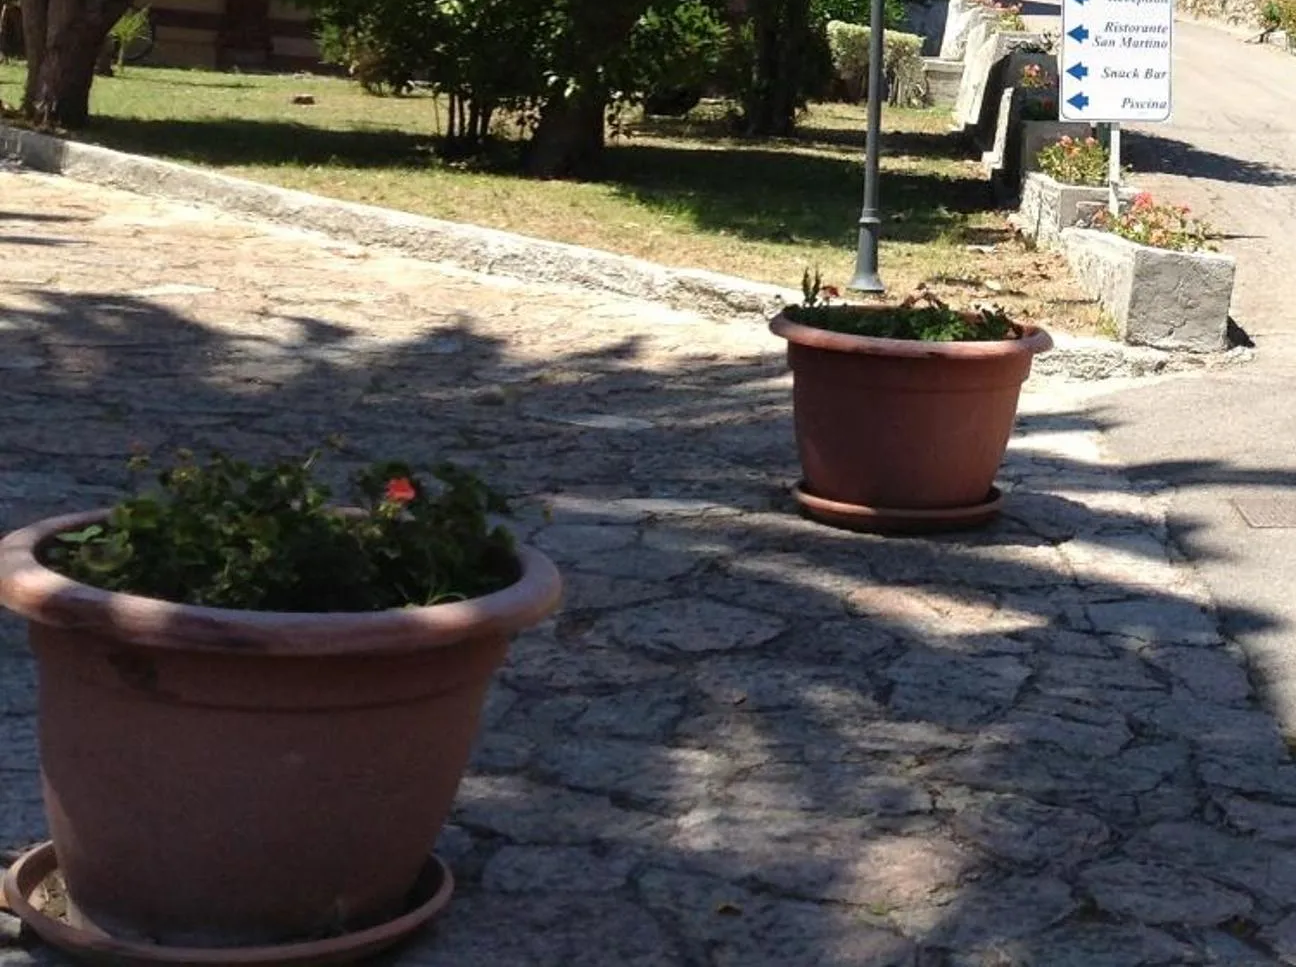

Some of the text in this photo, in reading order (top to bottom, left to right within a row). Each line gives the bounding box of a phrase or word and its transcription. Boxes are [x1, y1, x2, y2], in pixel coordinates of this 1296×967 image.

[1104, 22, 1168, 34] Ristorante
[1092, 36, 1168, 49] San Martino
[1102, 67, 1167, 79] Snack Bar
[1121, 97, 1167, 110] Piscina
